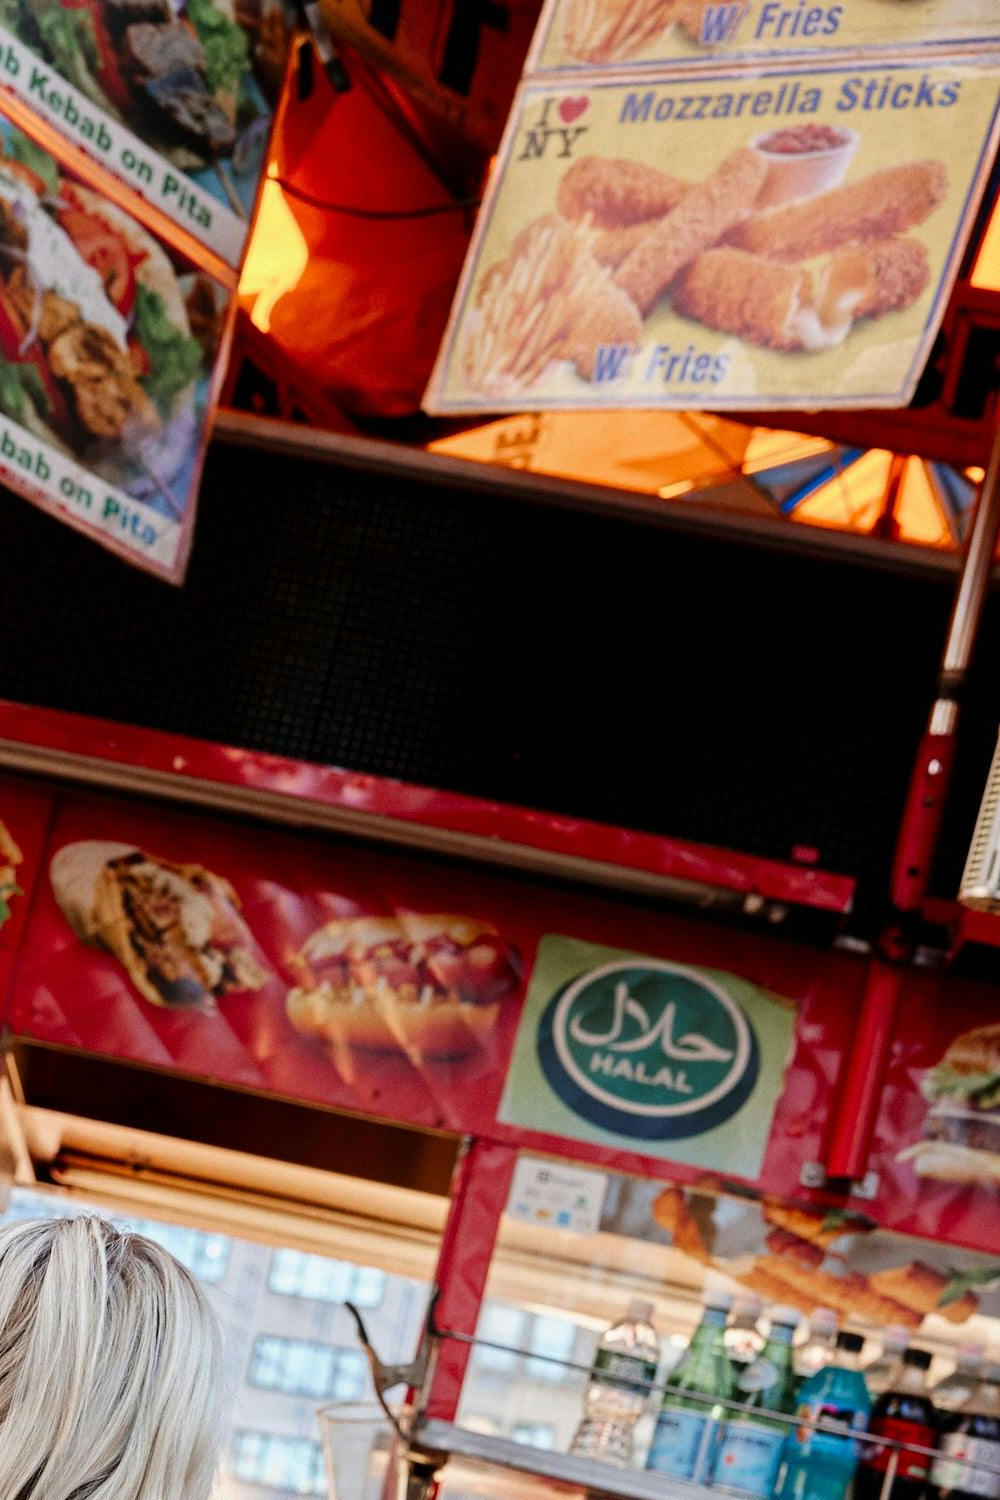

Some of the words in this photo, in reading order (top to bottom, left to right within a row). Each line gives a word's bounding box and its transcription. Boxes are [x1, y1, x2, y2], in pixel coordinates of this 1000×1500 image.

[754, 0, 843, 39] Fries
[536, 96, 559, 127] I
[618, 83, 822, 124] Mozzarella
[835, 75, 963, 113] Sticks
[29, 65, 113, 152] Kebab
[120, 148, 154, 183] on
[162, 173, 212, 229] Pita
[518, 125, 588, 162] NY
[645, 344, 729, 384] Fries
[59, 474, 93, 509] on
[102, 495, 158, 546] Pita
[569, 980, 734, 1063] حلال
[589, 1052, 694, 1095] HALAL
